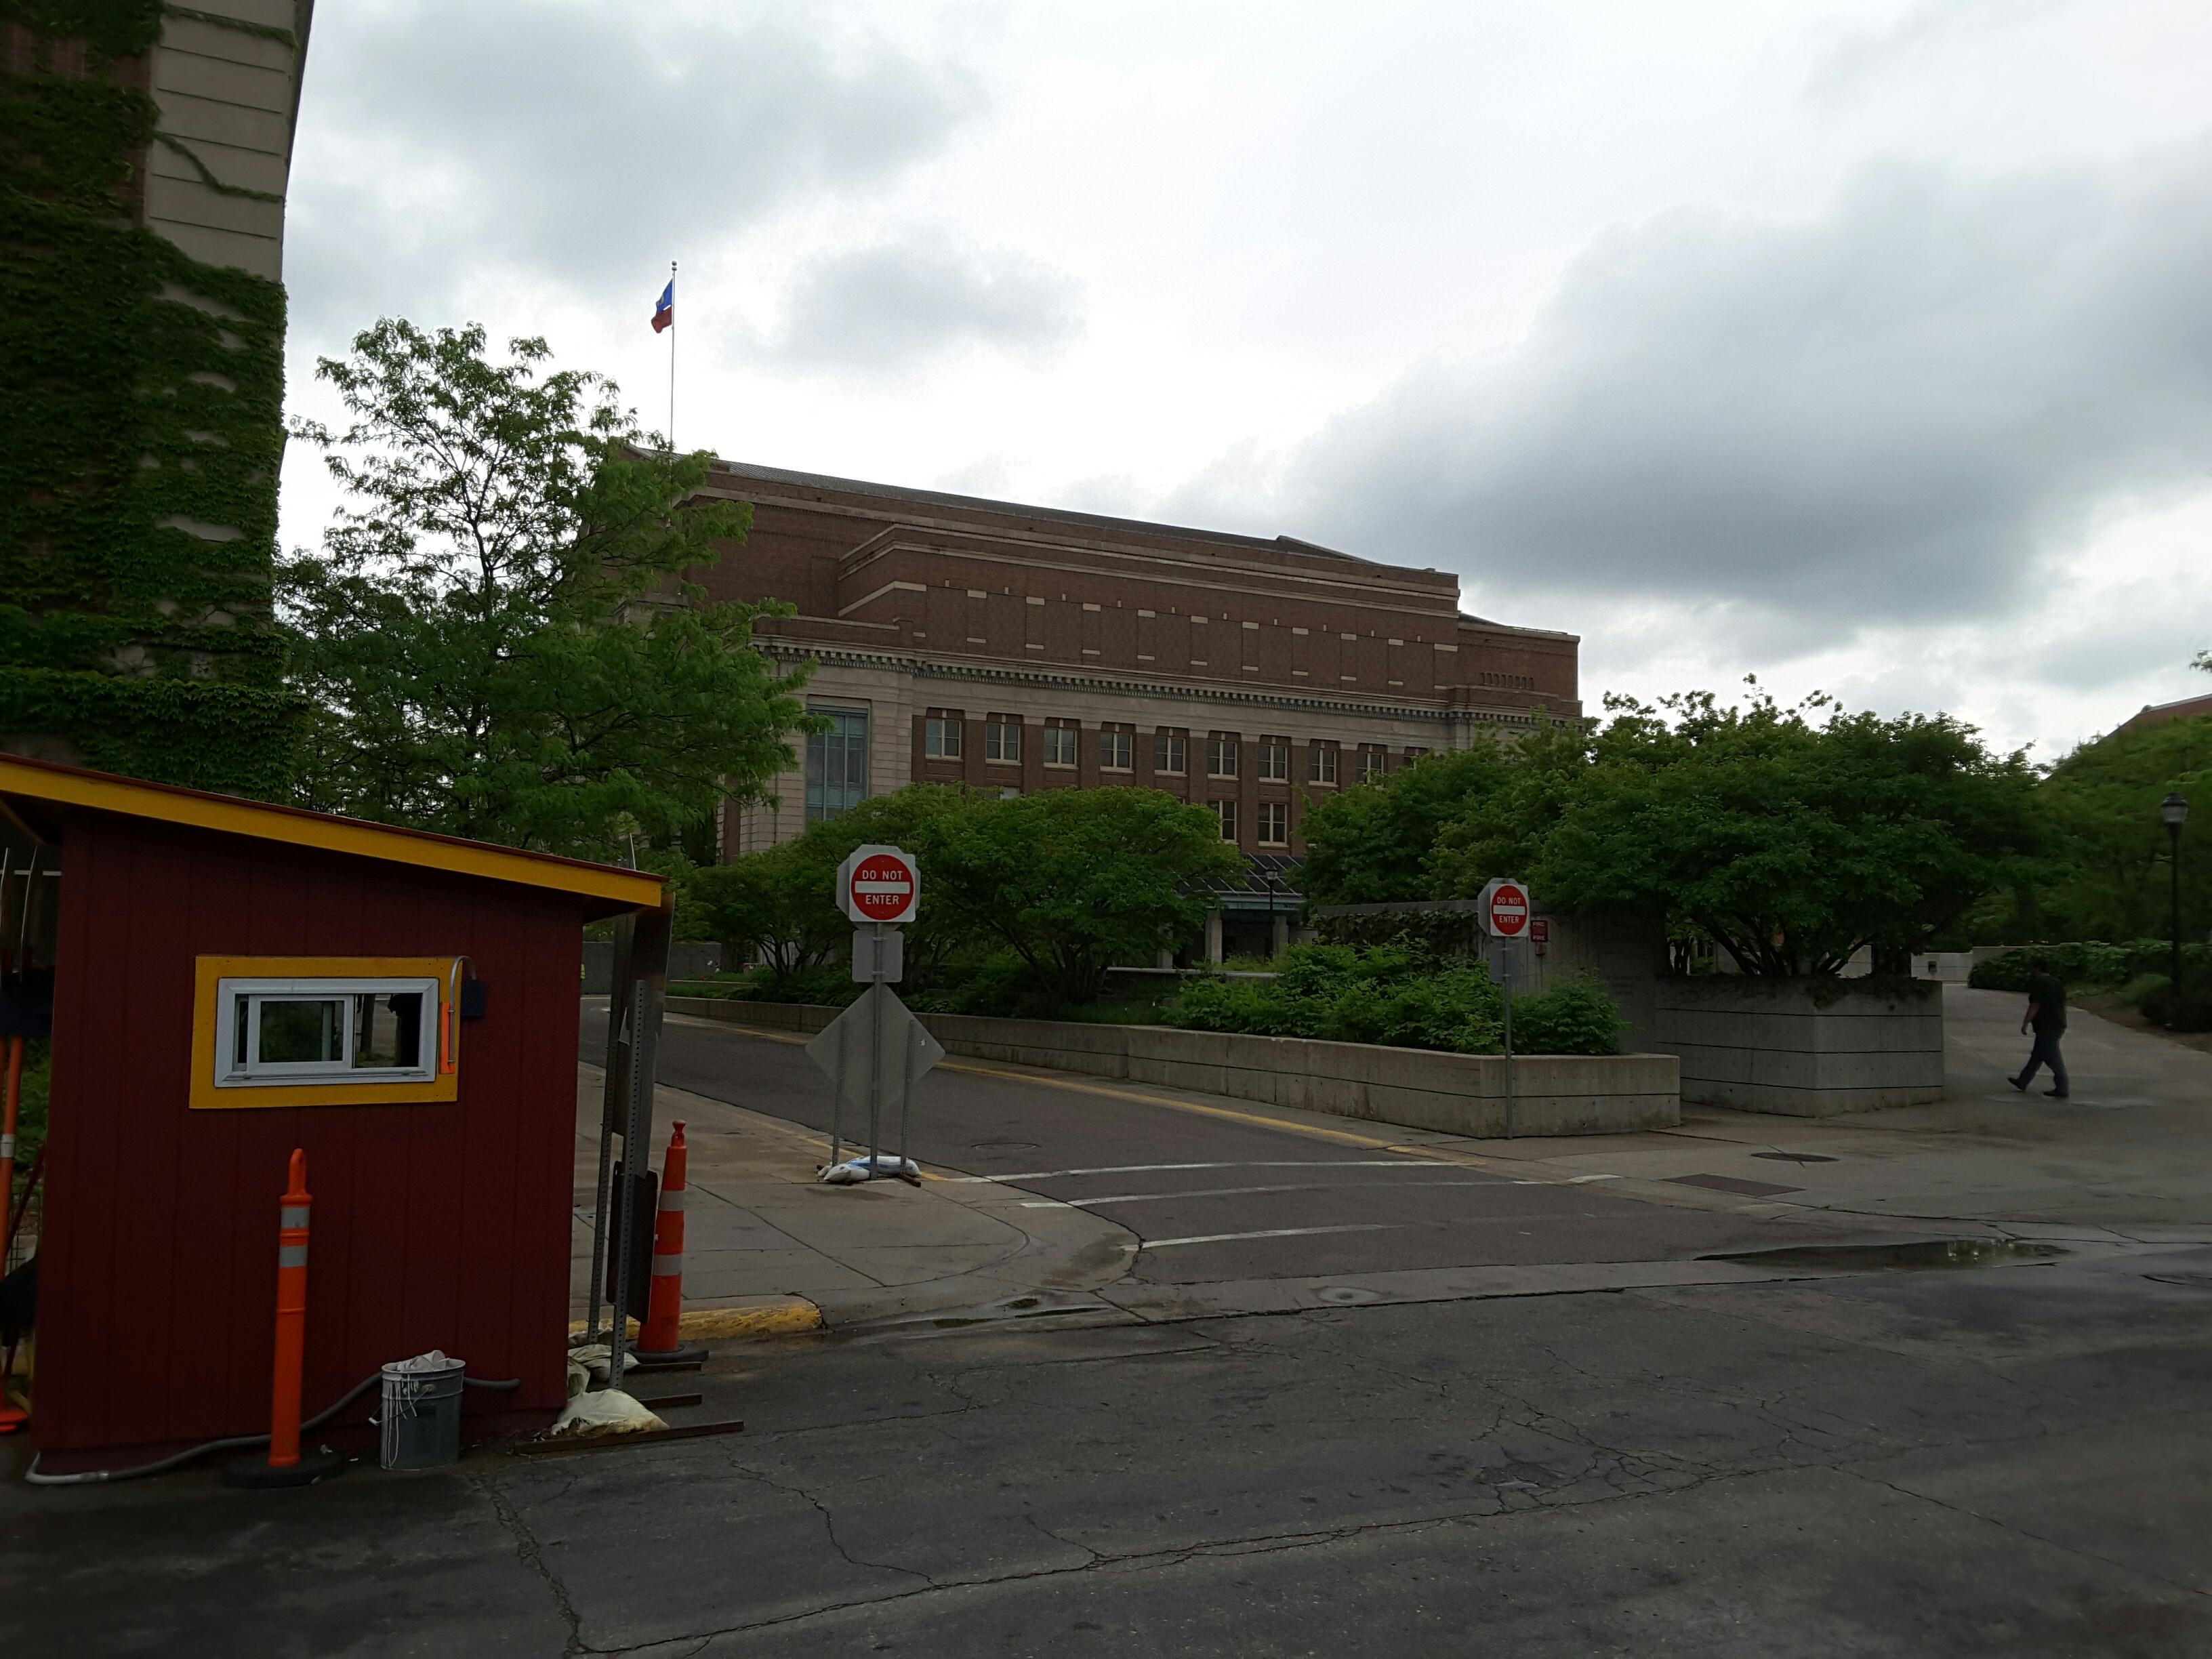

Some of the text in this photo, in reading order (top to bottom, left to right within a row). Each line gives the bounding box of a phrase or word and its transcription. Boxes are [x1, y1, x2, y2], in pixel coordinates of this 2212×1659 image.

[862, 869, 903, 880] DO NOT
[865, 895, 899, 905] ENTER
